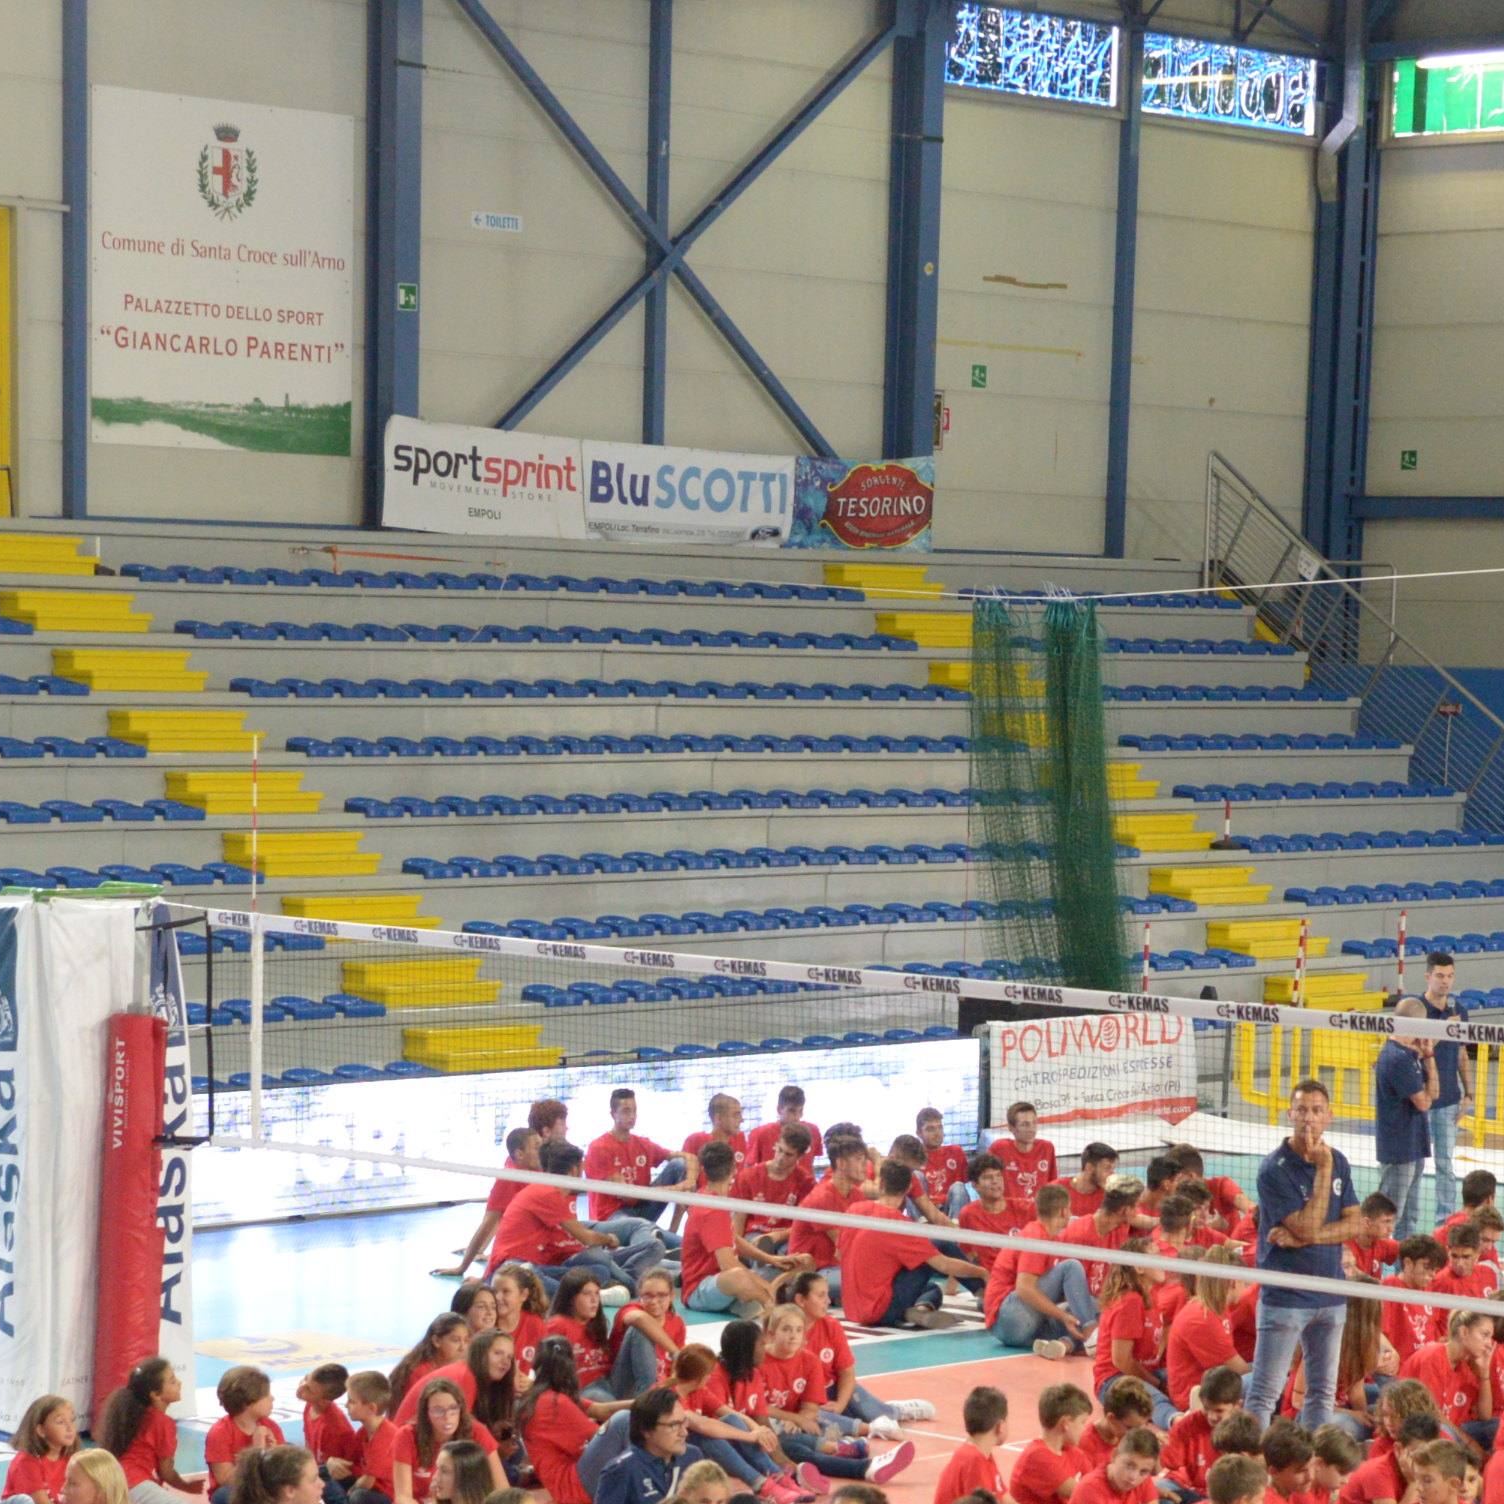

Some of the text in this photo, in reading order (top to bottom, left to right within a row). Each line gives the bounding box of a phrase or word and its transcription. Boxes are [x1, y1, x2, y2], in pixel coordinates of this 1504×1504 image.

[485, 214, 520, 230] TOILETTE
[101, 230, 346, 272] Comune di Santa Croce sull'Arno
[124, 293, 324, 326] PALAZZETTO DELLO SPORT
[393, 444, 577, 498] sportsprint
[429, 480, 553, 502] MOVEMENT STORE
[860, 474, 907, 492] SORGENTE
[468, 507, 502, 520] EMPOLI
[837, 495, 926, 518] TESORINO
[588, 521, 617, 531] EMPOLI
[639, 951, 675, 968] KEMAS
[730, 959, 767, 977] KEMAS
[823, 969, 862, 985] KEMAS
[921, 978, 961, 994] KEMAS
[1022, 987, 1063, 1004] KEMAS
[1127, 995, 1170, 1013] KEMAS
[1235, 1004, 1280, 1023] KEMAS
[1350, 1014, 1395, 1034] KEMAS
[1001, 1012, 1184, 1068] POLIWORLD
[112, 1037, 126, 1151] VIVISPORT
